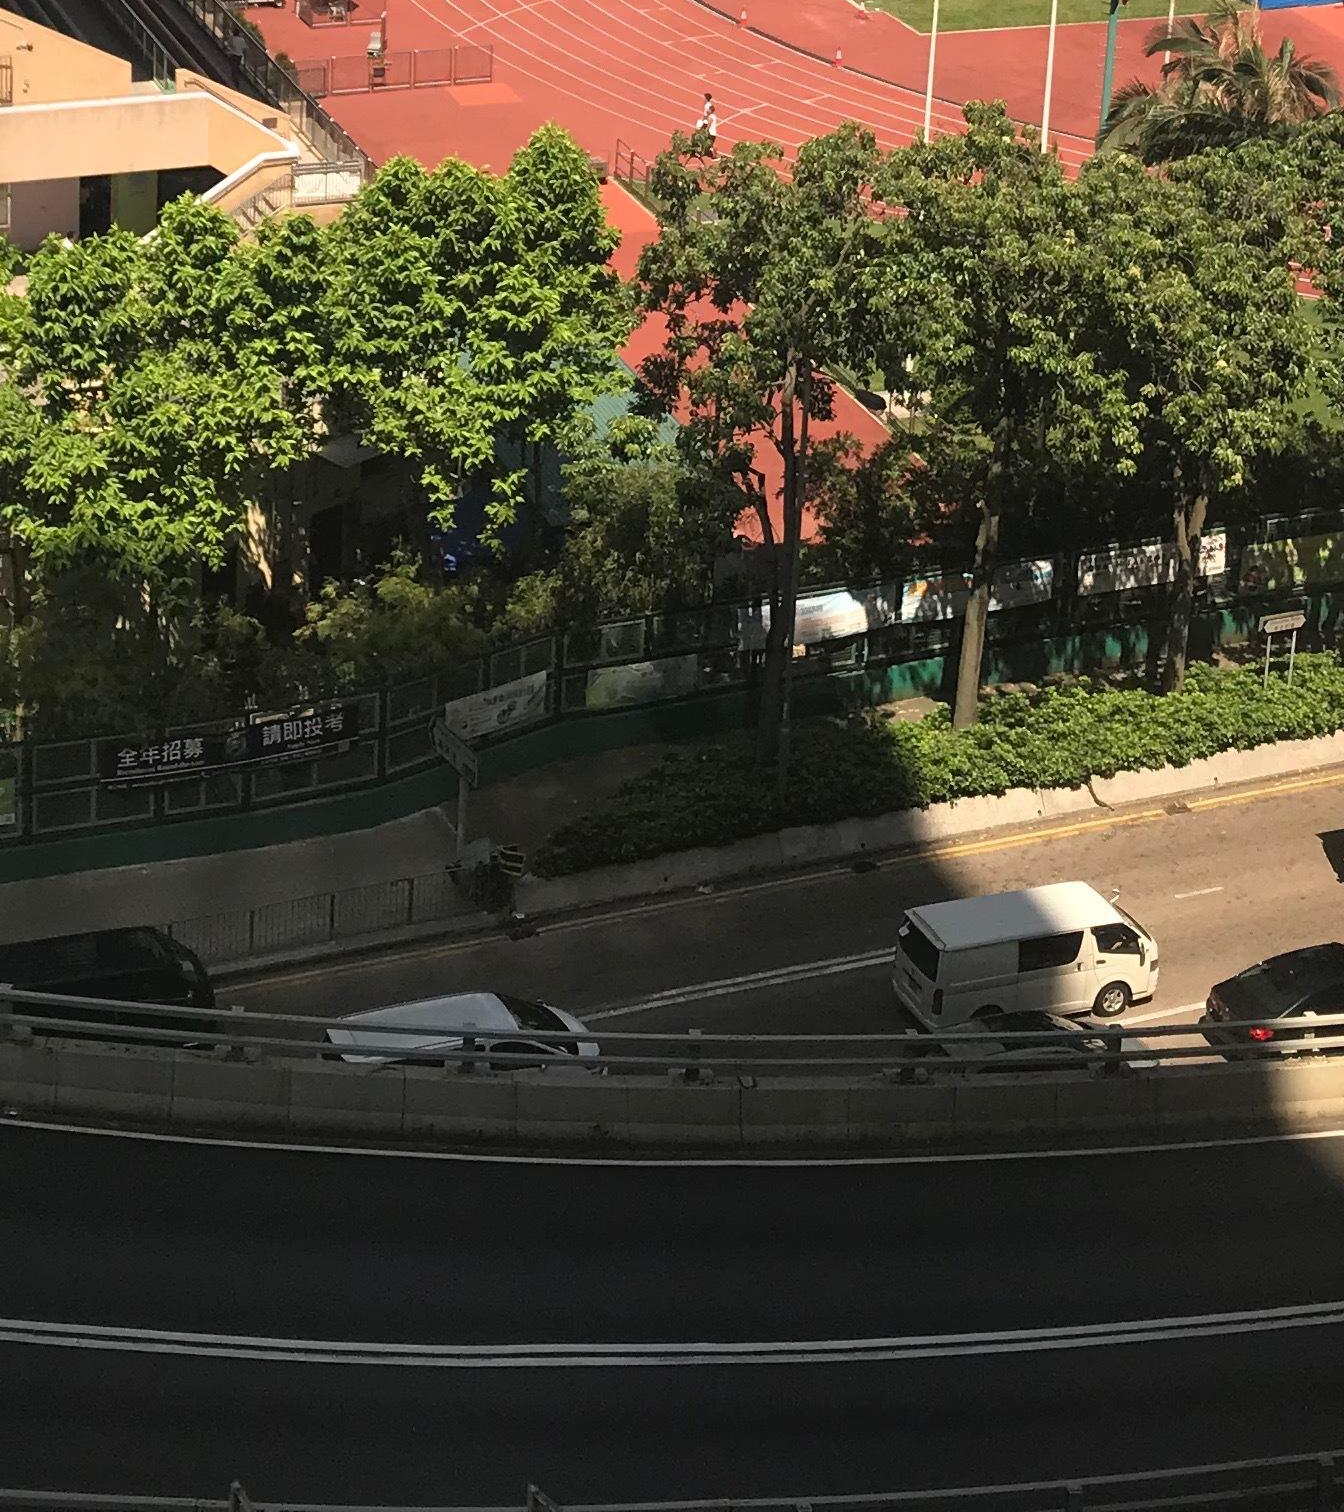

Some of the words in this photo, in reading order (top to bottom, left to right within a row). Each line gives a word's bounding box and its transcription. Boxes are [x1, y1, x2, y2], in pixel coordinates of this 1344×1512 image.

[116, 737, 204, 768] 全年招募
[261, 712, 344, 747] 請即投考
